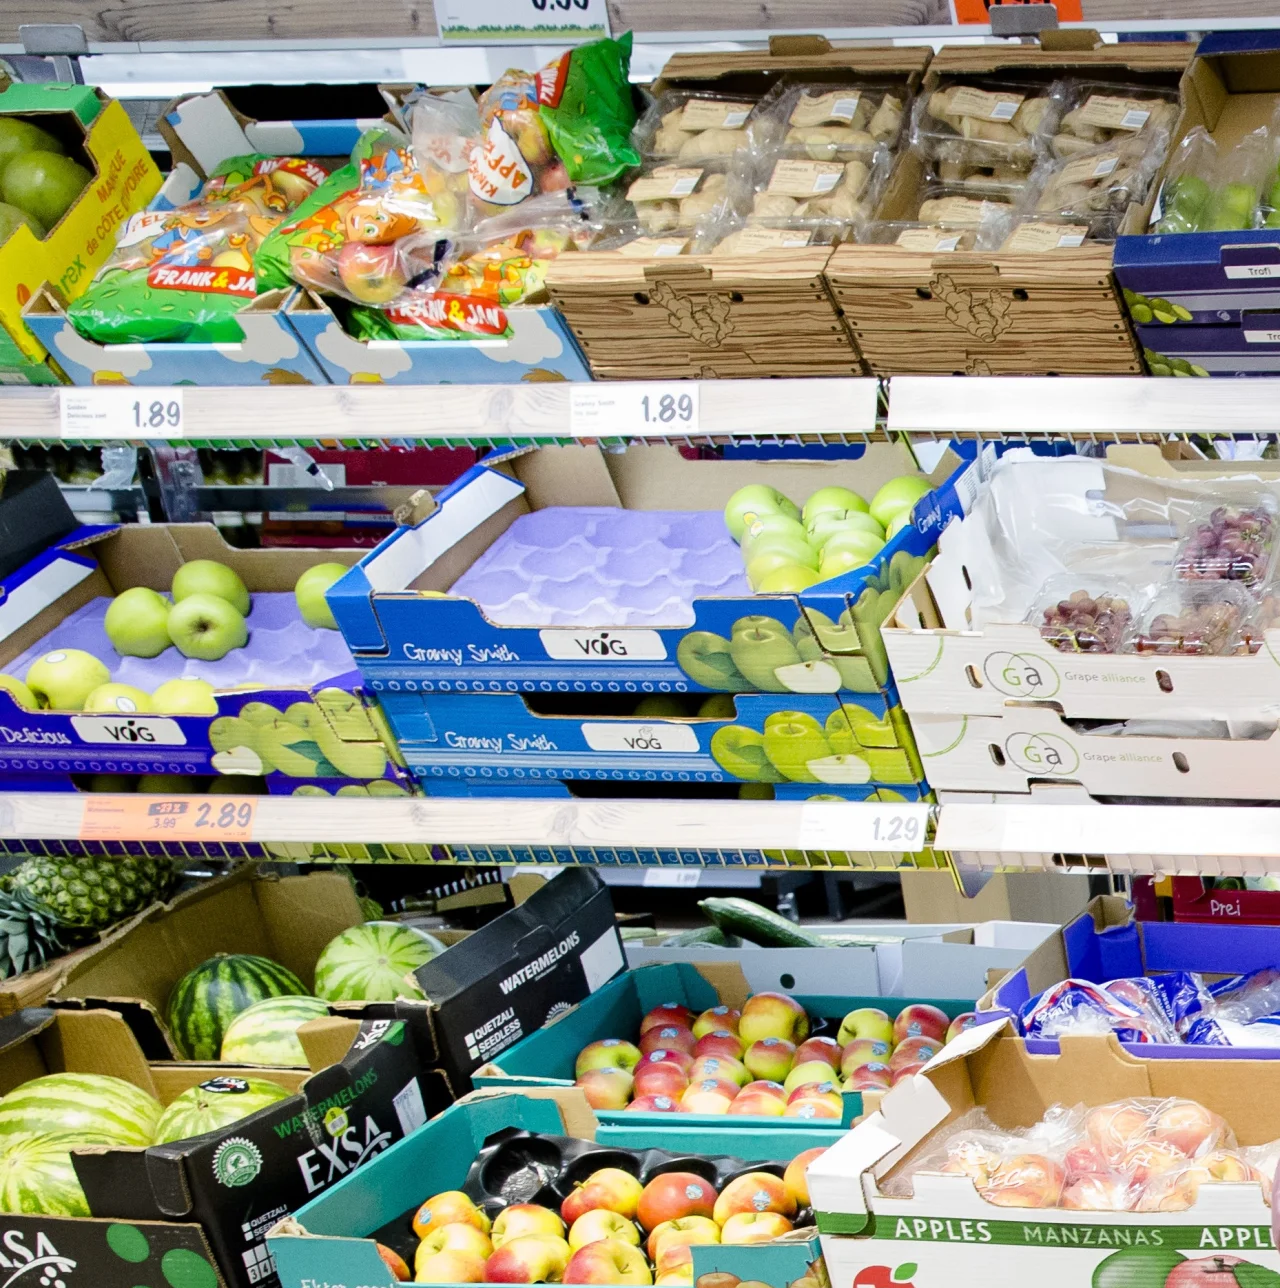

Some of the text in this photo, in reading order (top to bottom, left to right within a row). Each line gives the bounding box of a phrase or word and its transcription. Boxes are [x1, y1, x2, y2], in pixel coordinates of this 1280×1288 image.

[153, 269, 256, 291] FRANK & JA
[448, 300, 465, 323] &
[466, 304, 501, 328] JAN
[132, 400, 181, 427] 1.89
[641, 393, 694, 423] 1.89
[403, 642, 520, 665] Granny Smith
[1064, 670, 1145, 684] Grape alliance
[445, 731, 559, 754] Granny Smith
[623, 737, 662, 750] VOG
[1082, 752, 1162, 763] Grape alliance
[195, 802, 253, 829] 2.89
[872, 815, 919, 841] 1.29
[1210, 899, 1240, 916] Prei
[500, 930, 581, 995] WATERMELONS
[474, 1007, 515, 1040] QUETZALI
[478, 1019, 521, 1053] SEEDLESS
[297, 1115, 388, 1194] EXSA
[895, 1217, 1165, 1247] APPLES MANZANAS
